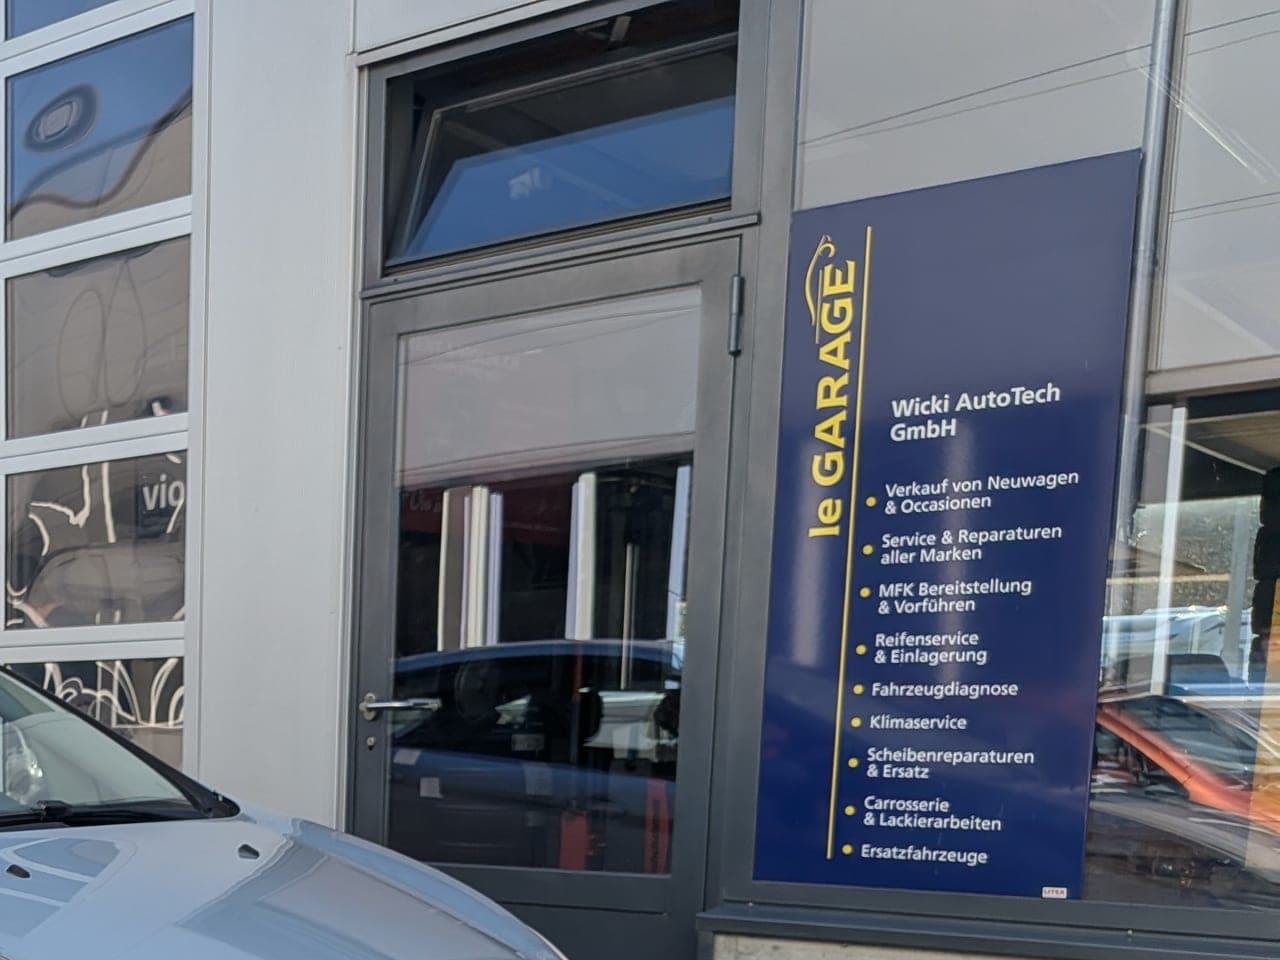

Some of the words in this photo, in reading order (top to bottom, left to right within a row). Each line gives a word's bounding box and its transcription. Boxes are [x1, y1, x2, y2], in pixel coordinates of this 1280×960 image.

[812, 259, 856, 486] GARAGE
[891, 394, 950, 418] Wicki
[954, 382, 1061, 412] AutoTech
[890, 418, 957, 442] GmbH
[885, 478, 949, 498] Verkauf
[952, 480, 982, 493] von
[987, 471, 1079, 490] Neuwagen
[884, 501, 897, 515] &
[900, 495, 992, 514] Occasionen
[808, 497, 842, 538] le
[881, 532, 937, 549] Service
[940, 530, 953, 545] &
[957, 525, 1062, 546] Reparaturen
[880, 551, 915, 565] aller
[920, 547, 982, 563] Marken
[878, 583, 915, 598] MFK
[918, 578, 1032, 597] Bereitstellung
[877, 600, 890, 614] &
[894, 598, 976, 614] Vorführen
[875, 631, 979, 647] Reifenservice
[874, 651, 886, 664] &
[890, 649, 988, 666] Einlagerung
[871, 681, 1019, 700] Fahrzeugdiagnose
[869, 715, 968, 730] Klimaservice
[867, 747, 1035, 765] Scheibenreparaturen
[866, 763, 879, 778] &
[883, 764, 929, 779] Ersatz
[864, 796, 950, 812] Carrosserie
[863, 812, 875, 826] &
[879, 812, 1002, 831] Lackierarbeiten
[860, 844, 988, 867] Ersatzfahrzeuge
